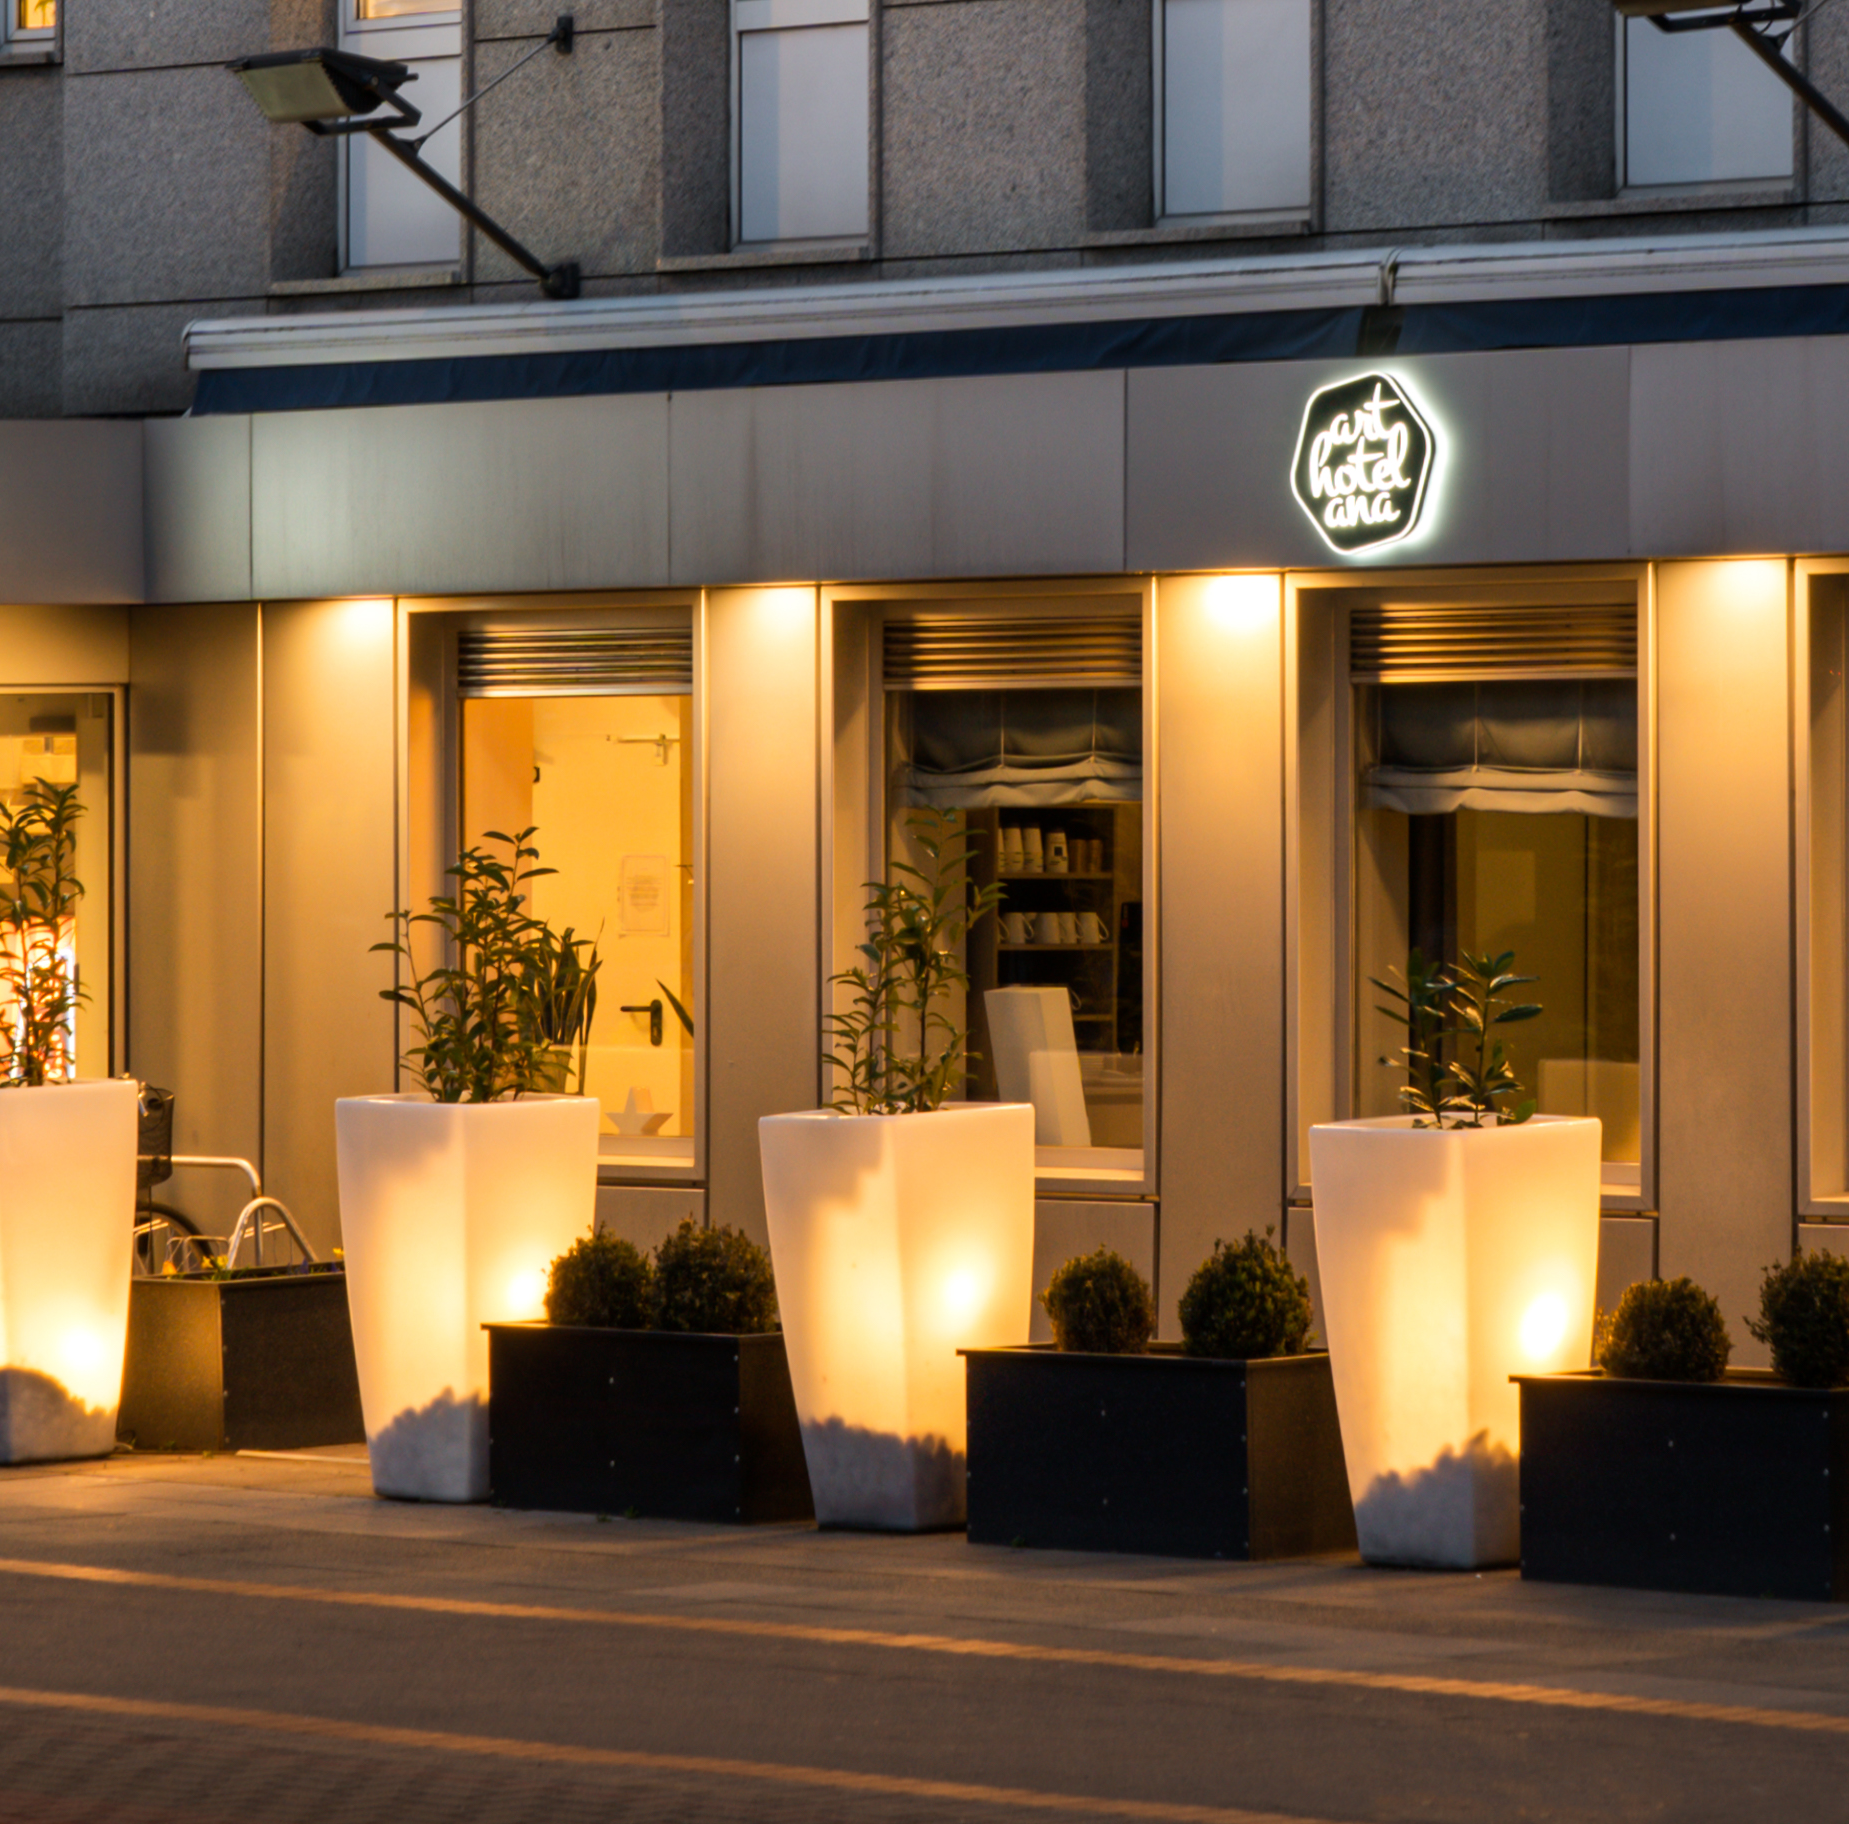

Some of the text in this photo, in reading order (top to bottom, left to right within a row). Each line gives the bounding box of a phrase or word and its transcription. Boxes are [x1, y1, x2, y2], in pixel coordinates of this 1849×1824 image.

[1329, 382, 1401, 445] art
[1308, 421, 1412, 499] hotel
[1323, 491, 1401, 529] ana
